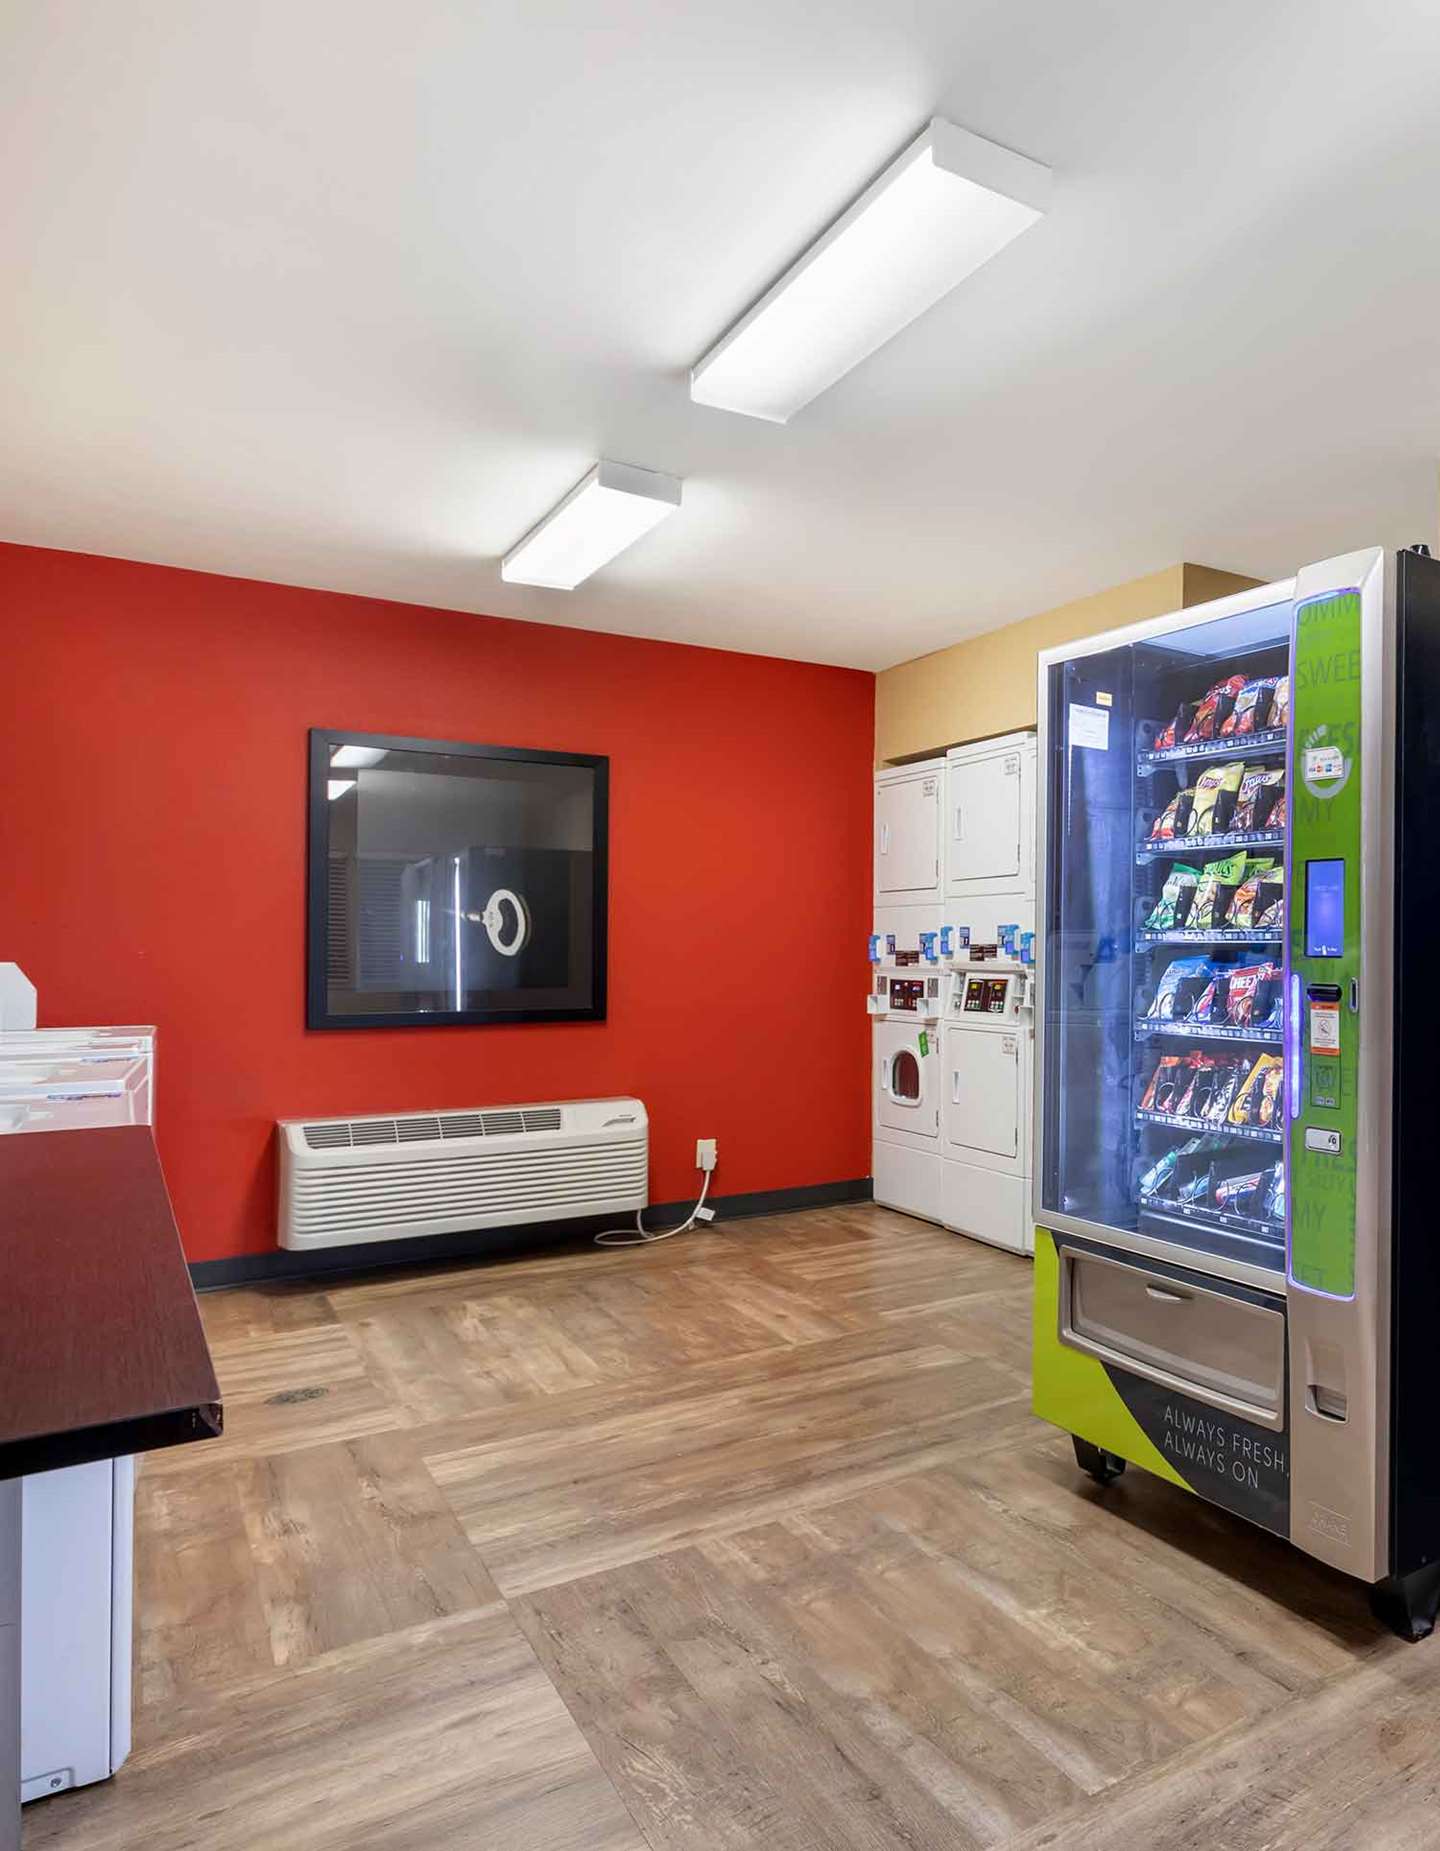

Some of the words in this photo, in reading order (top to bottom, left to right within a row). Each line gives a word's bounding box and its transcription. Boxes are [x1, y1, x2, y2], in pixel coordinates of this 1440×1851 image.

[1163, 1405, 1225, 1447] ALWAYS
[1232, 1433, 1290, 1478] FRESH,
[1163, 1430, 1225, 1474] ALWAYS
[1232, 1461, 1259, 1489] ON
